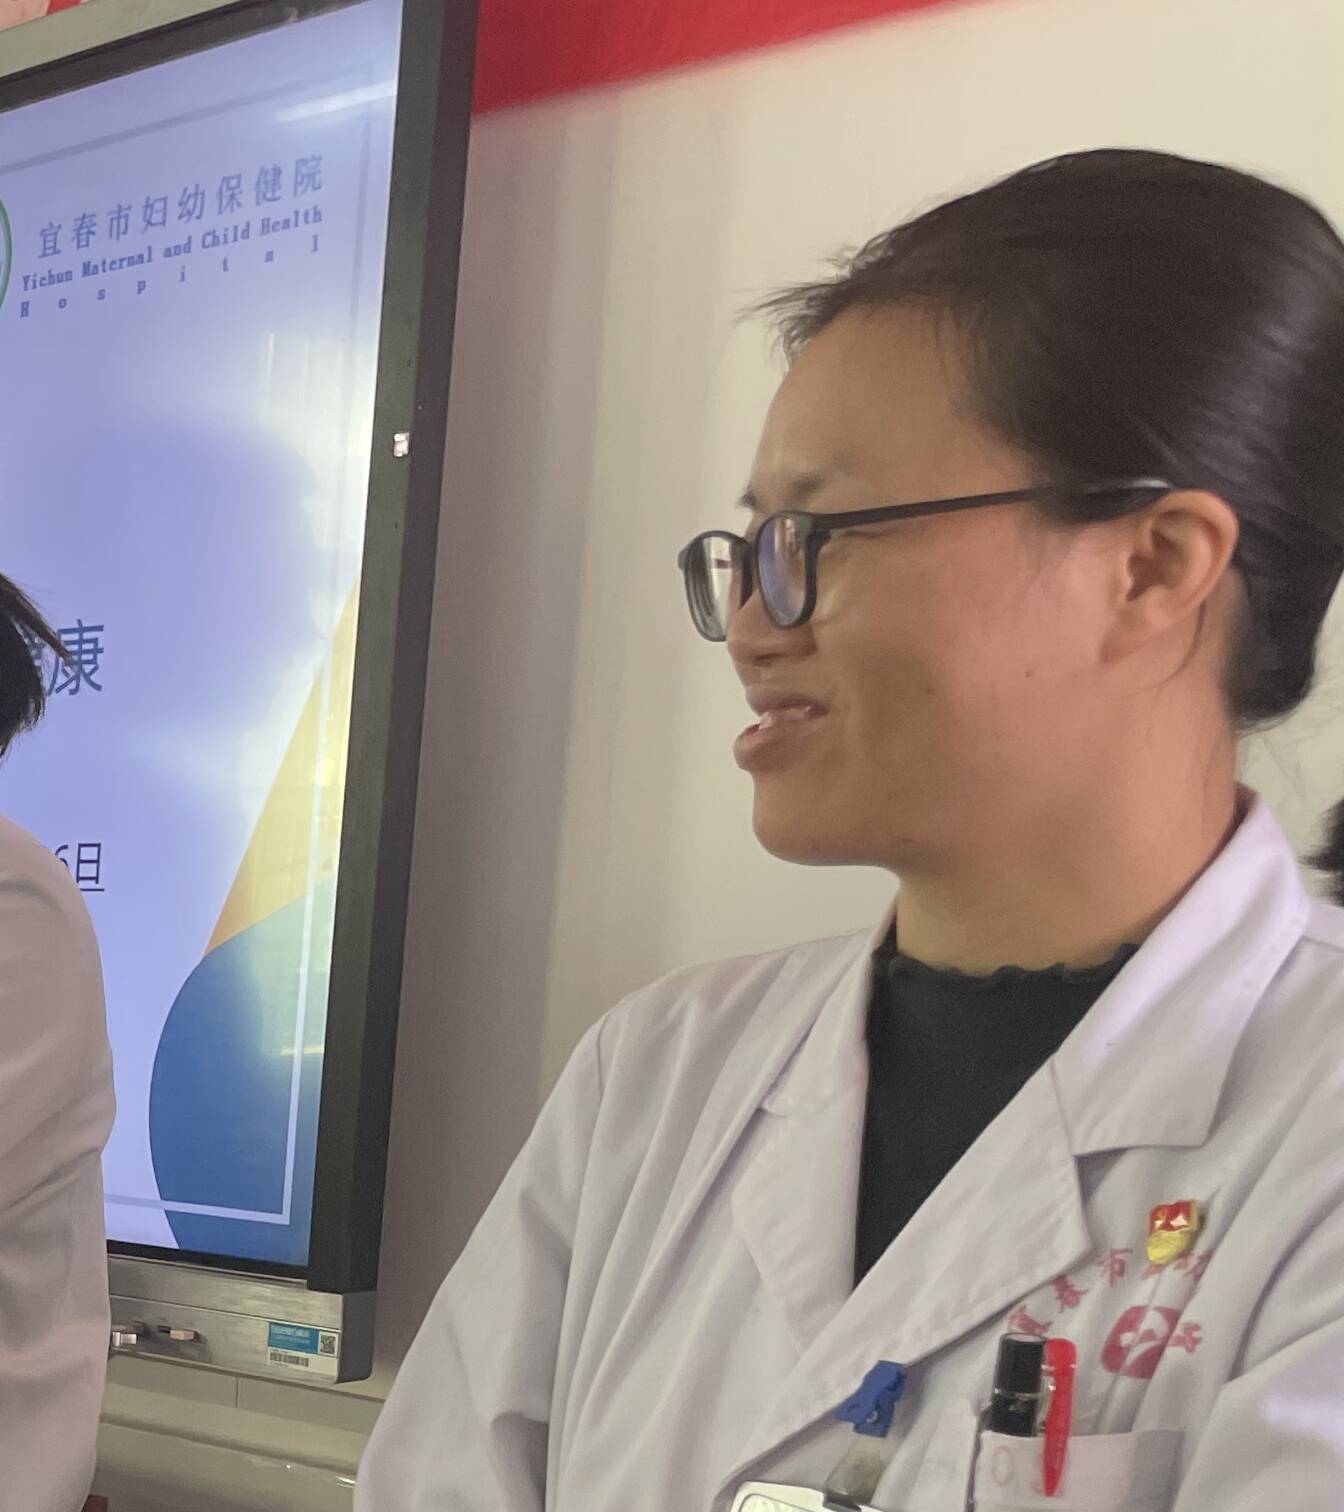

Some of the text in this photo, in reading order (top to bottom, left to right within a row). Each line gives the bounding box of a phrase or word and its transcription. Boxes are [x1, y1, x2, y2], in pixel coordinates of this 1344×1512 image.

[23, 205, 323, 292] Yichun Maternal and Child Health
[38, 155, 323, 259] 宜春市妇幼保健院
